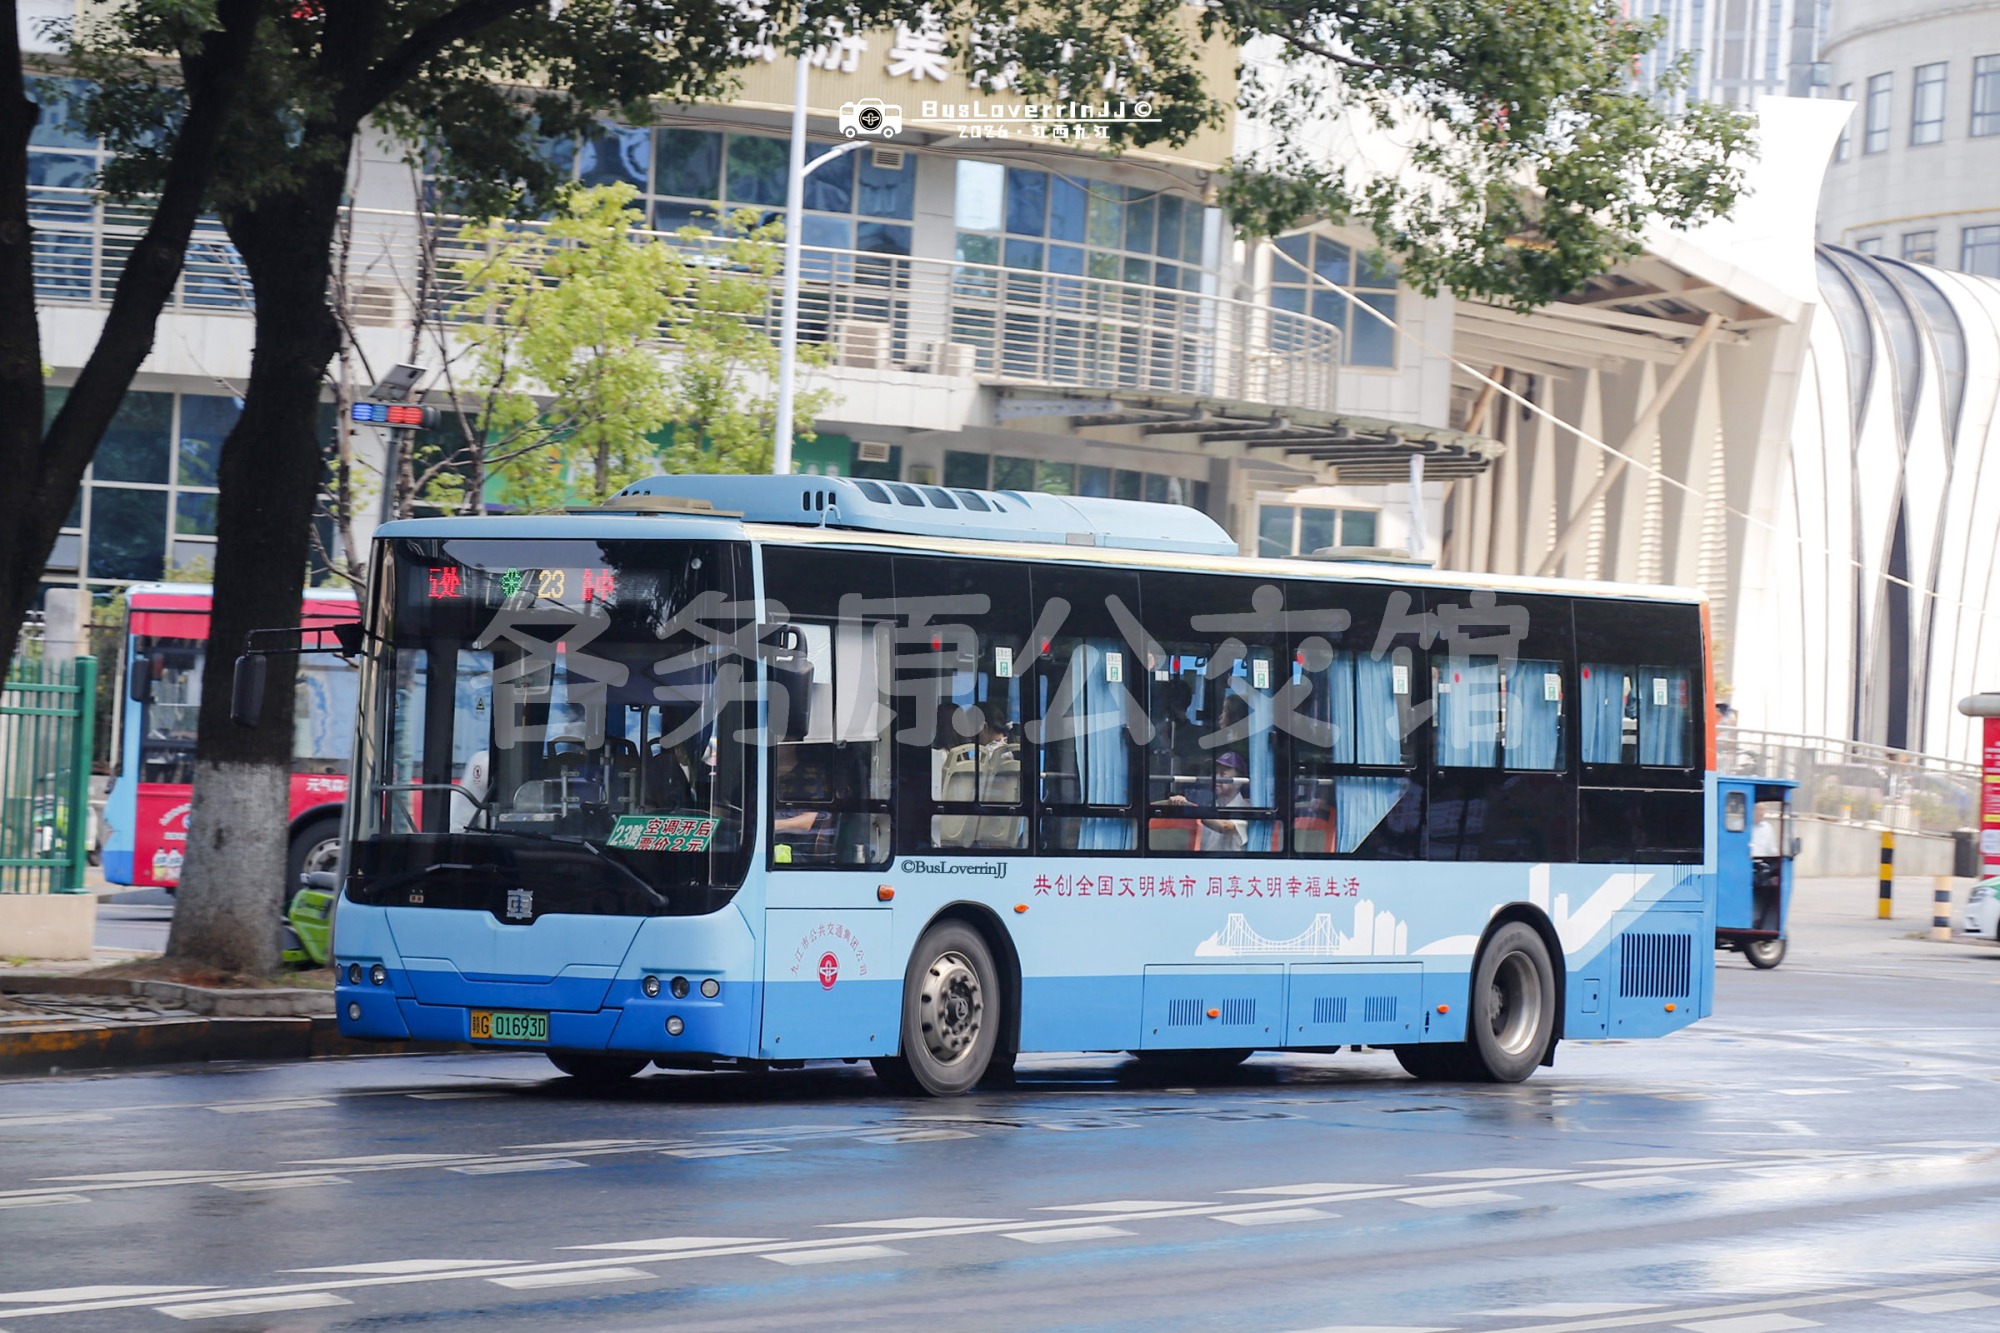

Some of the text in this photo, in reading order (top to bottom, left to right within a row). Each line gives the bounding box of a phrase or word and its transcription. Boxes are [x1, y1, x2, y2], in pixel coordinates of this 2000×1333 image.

[538, 569, 565, 598] 23
[306, 778, 348, 792] 元气森
[644, 818, 713, 837] 空调开启
[1033, 874, 1360, 898] 共创全国文明城市 同享文明幸福生活
